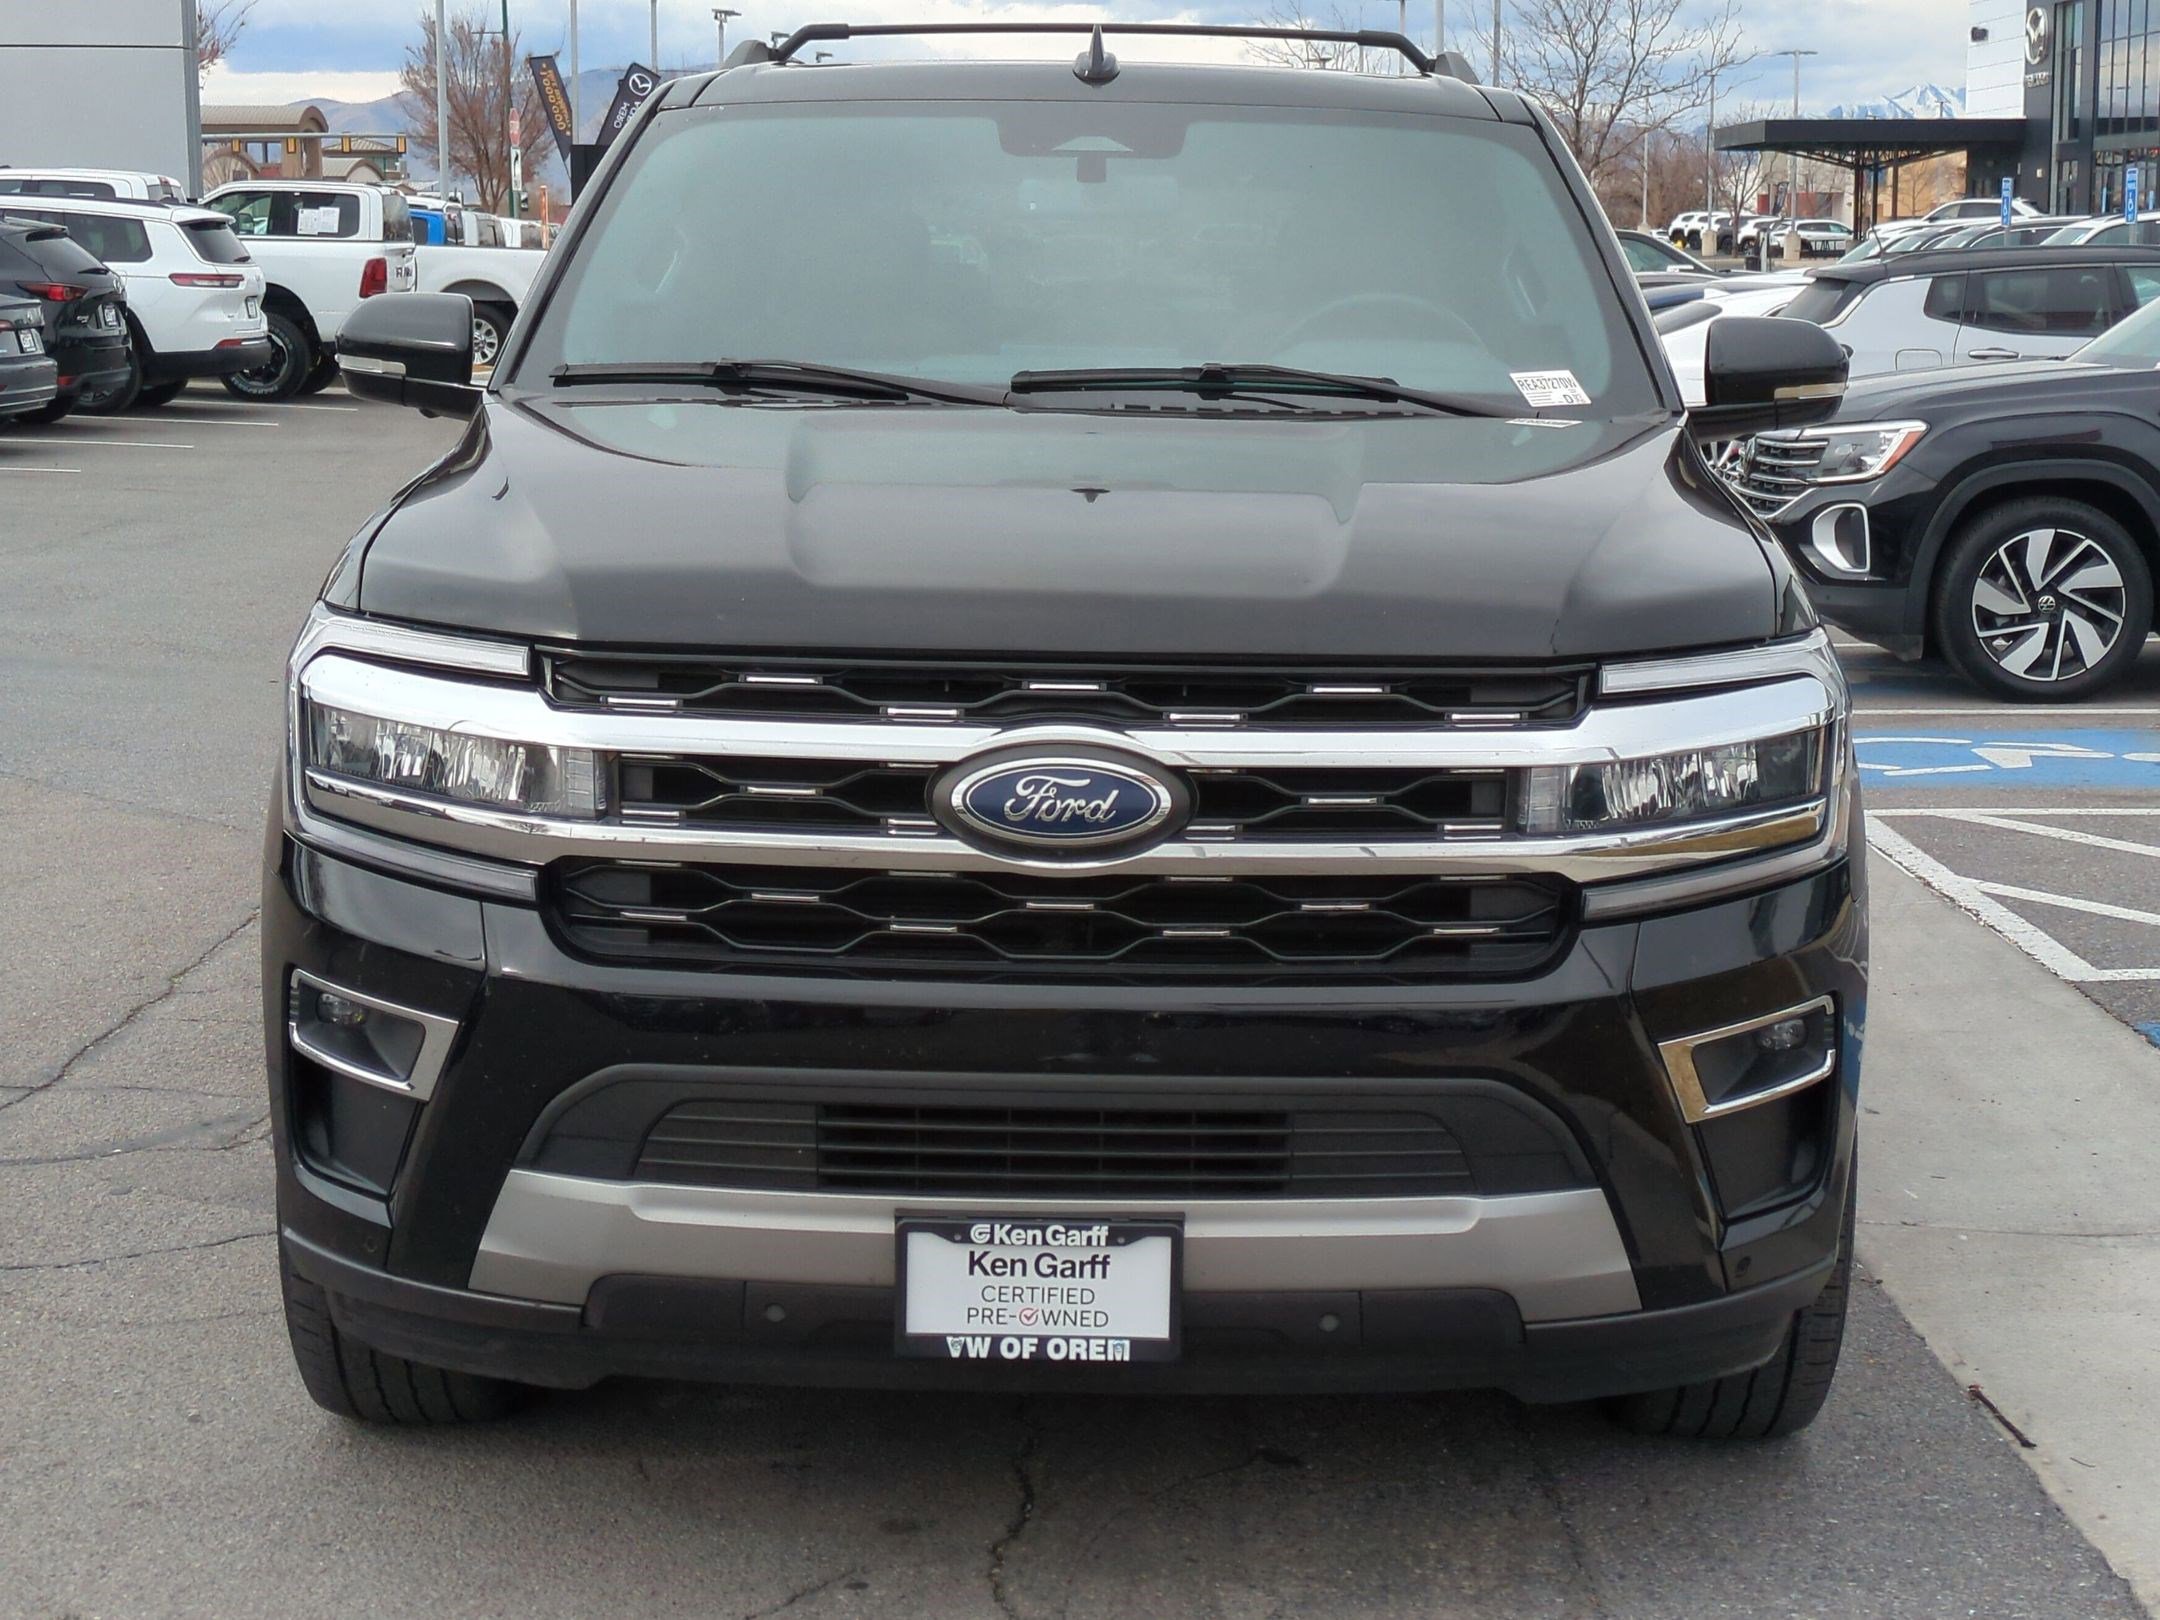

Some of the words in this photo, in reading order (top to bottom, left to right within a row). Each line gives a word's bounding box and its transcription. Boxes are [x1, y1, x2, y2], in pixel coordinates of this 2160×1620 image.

[614, 102, 630, 128] OREM
[1004, 775, 1119, 823] Ford
[994, 1224, 1042, 1246] Ken
[1045, 1225, 1109, 1247] Garff
[968, 1251, 1027, 1277] Ken
[1034, 1252, 1111, 1279] Garff
[981, 1285, 1095, 1305] CERTIFIED
[946, 1336, 991, 1359] VW
[1000, 1338, 1038, 1360] OF
[1047, 1338, 1130, 1361] OREM
